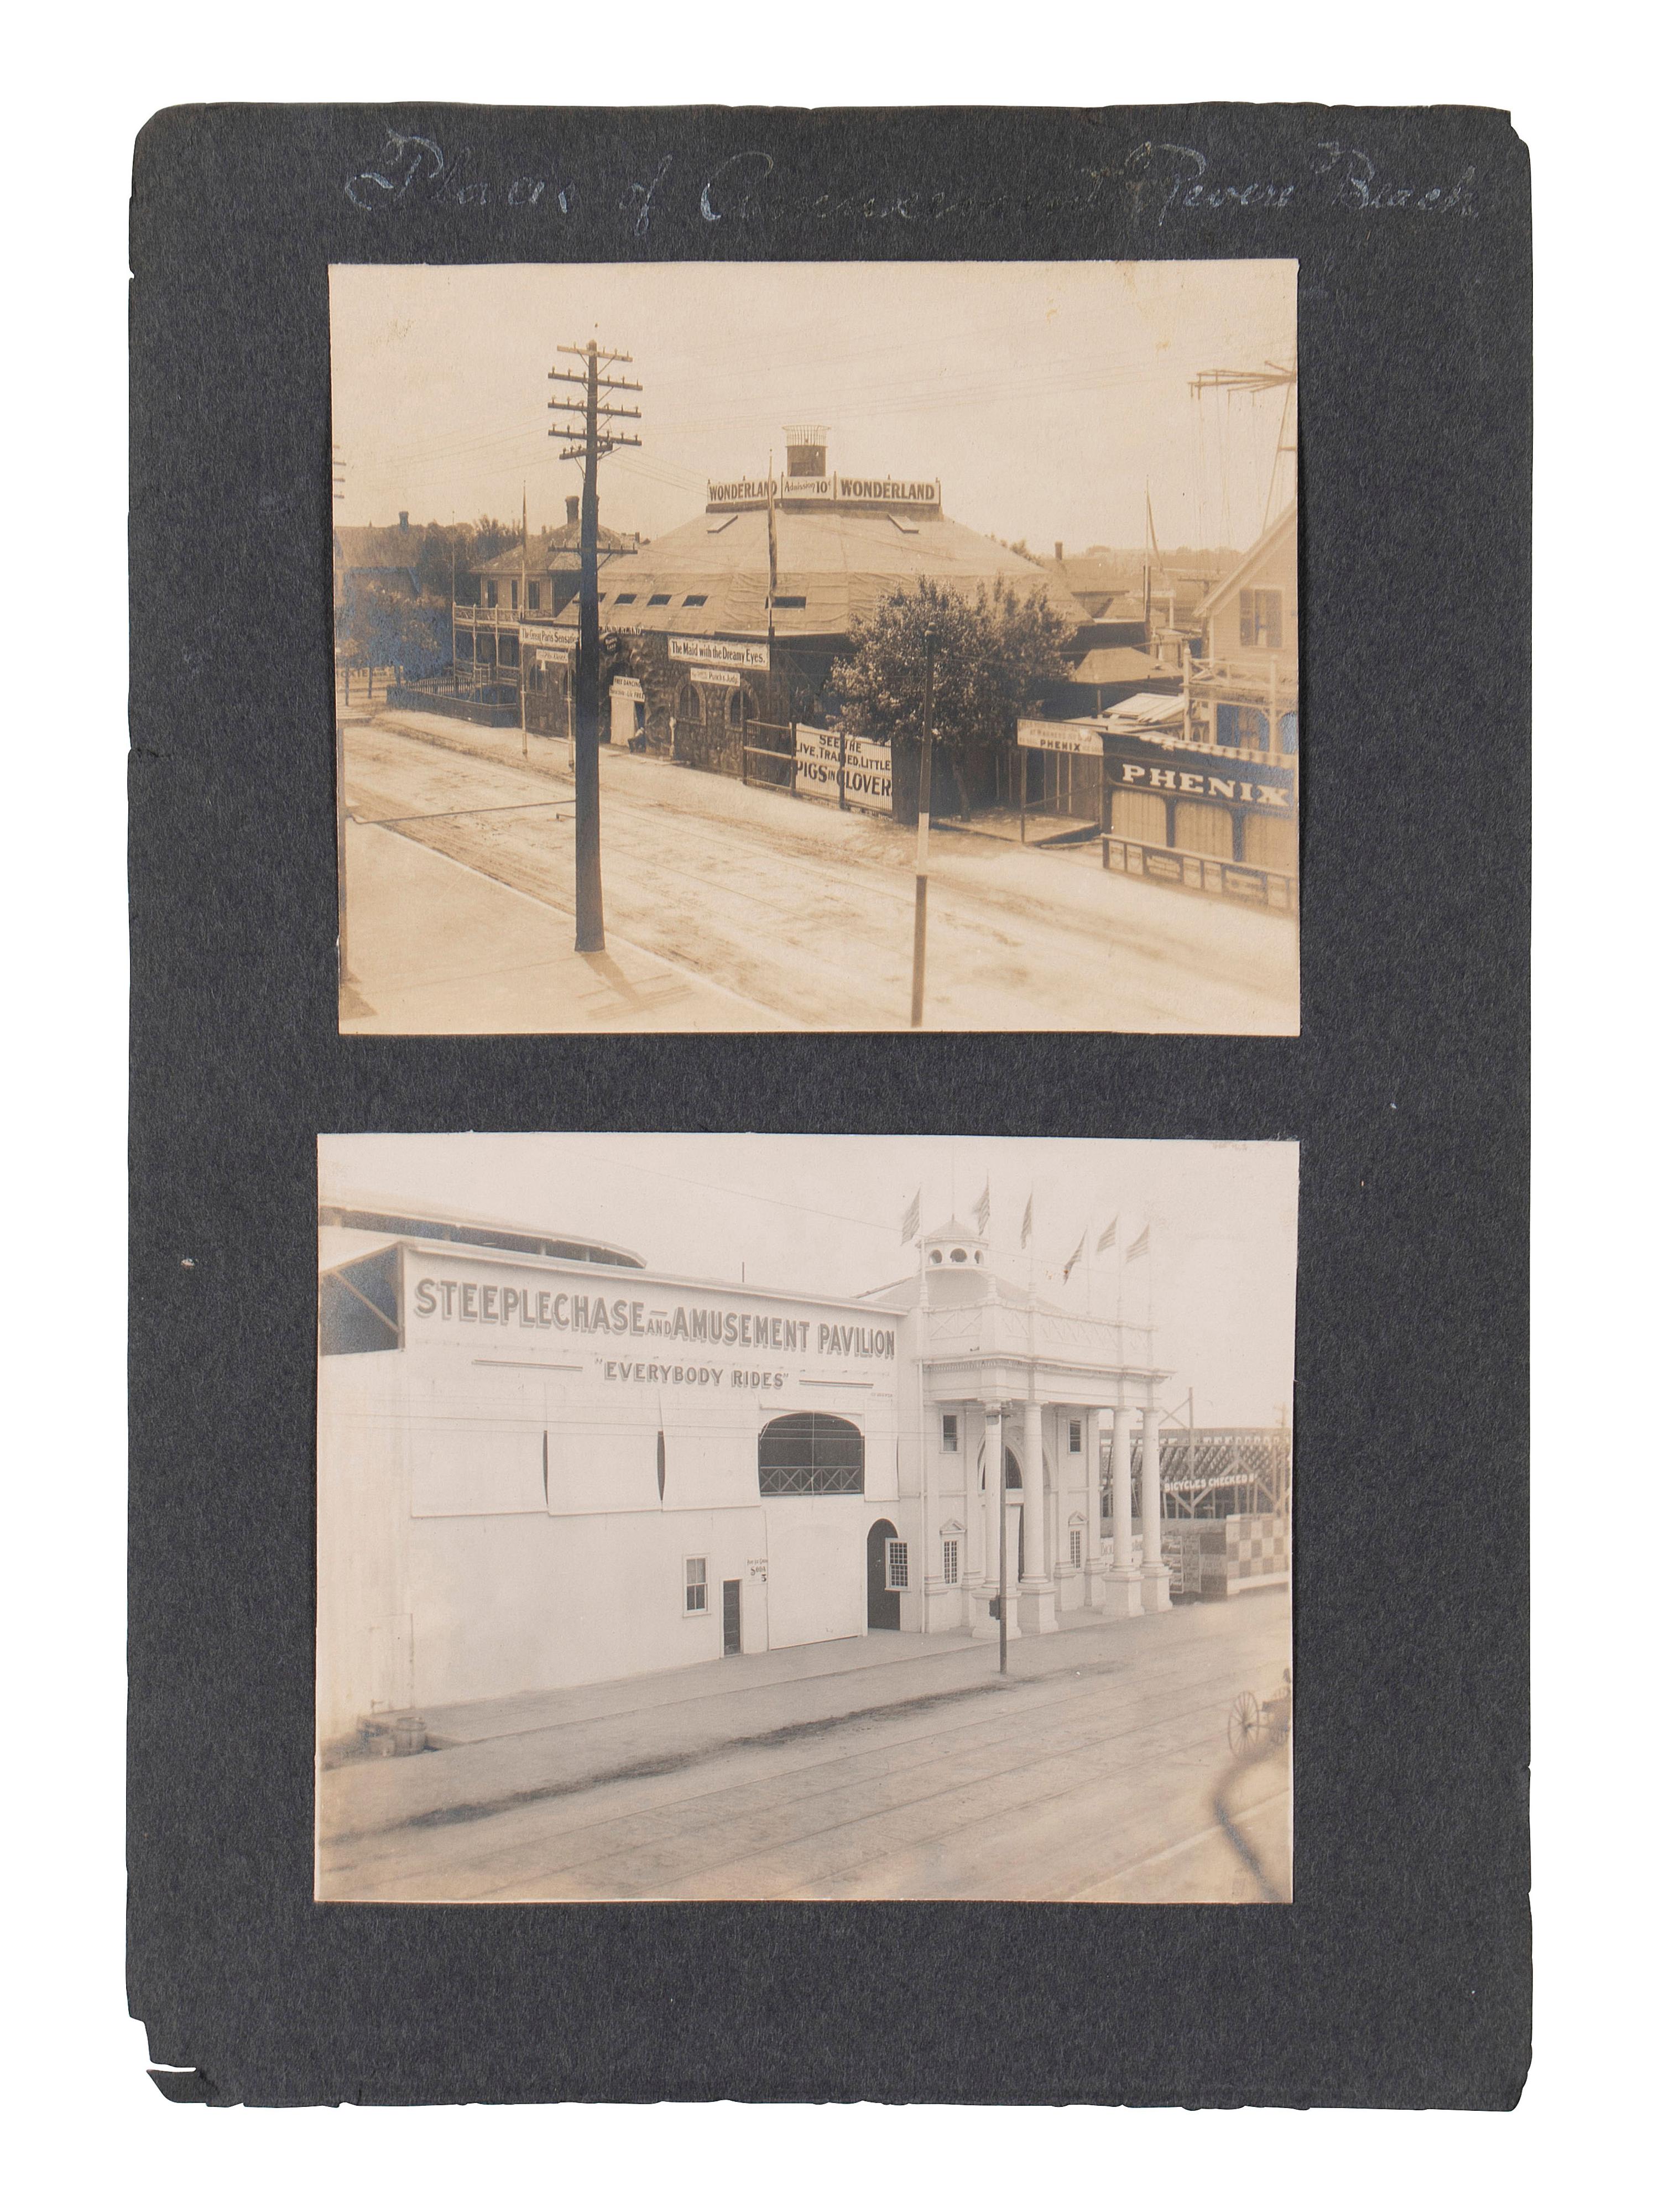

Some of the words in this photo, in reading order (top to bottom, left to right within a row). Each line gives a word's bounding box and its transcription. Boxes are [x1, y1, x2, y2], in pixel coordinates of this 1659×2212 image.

[709, 480, 778, 501] WONDERLAND
[784, 481, 815, 493] Admission
[841, 479, 935, 500] WONDERLAND
[542, 630, 554, 641] Paris
[671, 640, 682, 654] The
[683, 642, 698, 656] Maid
[699, 644, 712, 658] with
[712, 646, 722, 659] the
[722, 646, 745, 663] Dreamy
[746, 649, 765, 664] Eyes.
[819, 735, 840, 748] SEE
[845, 740, 862, 754] THE
[1040, 739, 1081, 753] PHENIX
[861, 756, 891, 771] LITTLE
[1122, 763, 1290, 807] PHENIX
[414, 1278, 646, 1337] STEEPLECHASE
[646, 1317, 671, 1337] AND
[670, 1306, 811, 1353] AMUSEMENT
[818, 1323, 896, 1360] PAVILION
[594, 1358, 724, 1387] "EVERYBODY
[731, 1370, 790, 1389] RIDES"
[1164, 1478, 1207, 1493] BICYCLES
[1208, 1473, 1248, 1488] CHECKED
